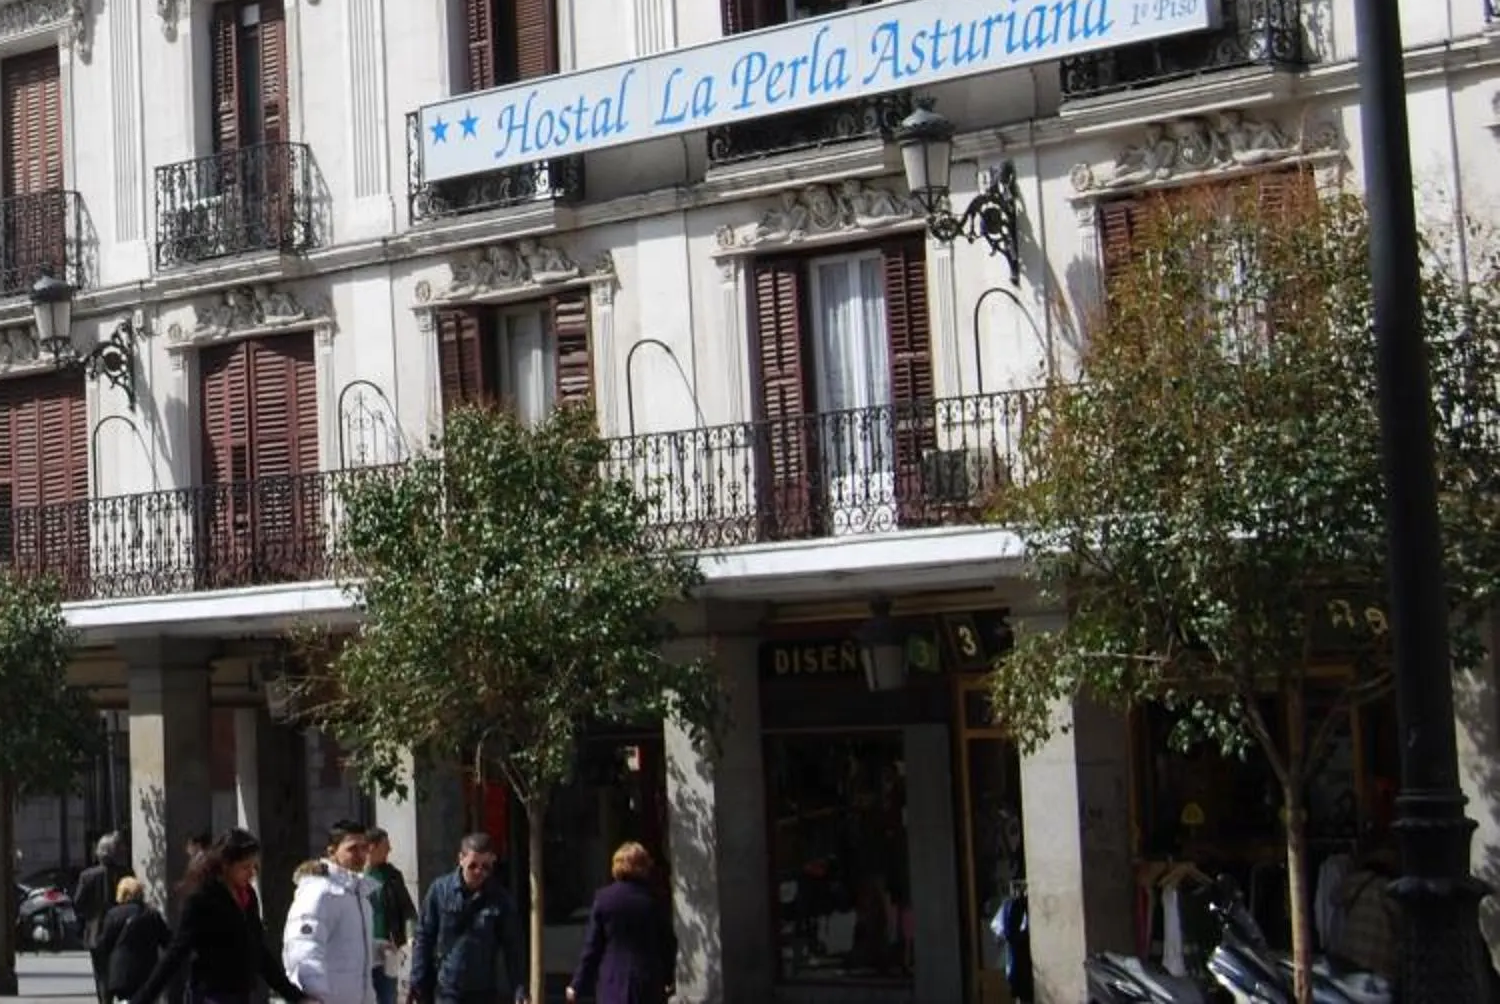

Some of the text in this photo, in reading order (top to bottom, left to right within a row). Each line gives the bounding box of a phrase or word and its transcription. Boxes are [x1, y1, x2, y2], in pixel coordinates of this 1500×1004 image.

[494, 67, 636, 159] Hostal
[654, 67, 717, 125] La
[731, 24, 851, 110] Perla
[774, 640, 857, 676] DISEÑ
[957, 624, 977, 657] 3
